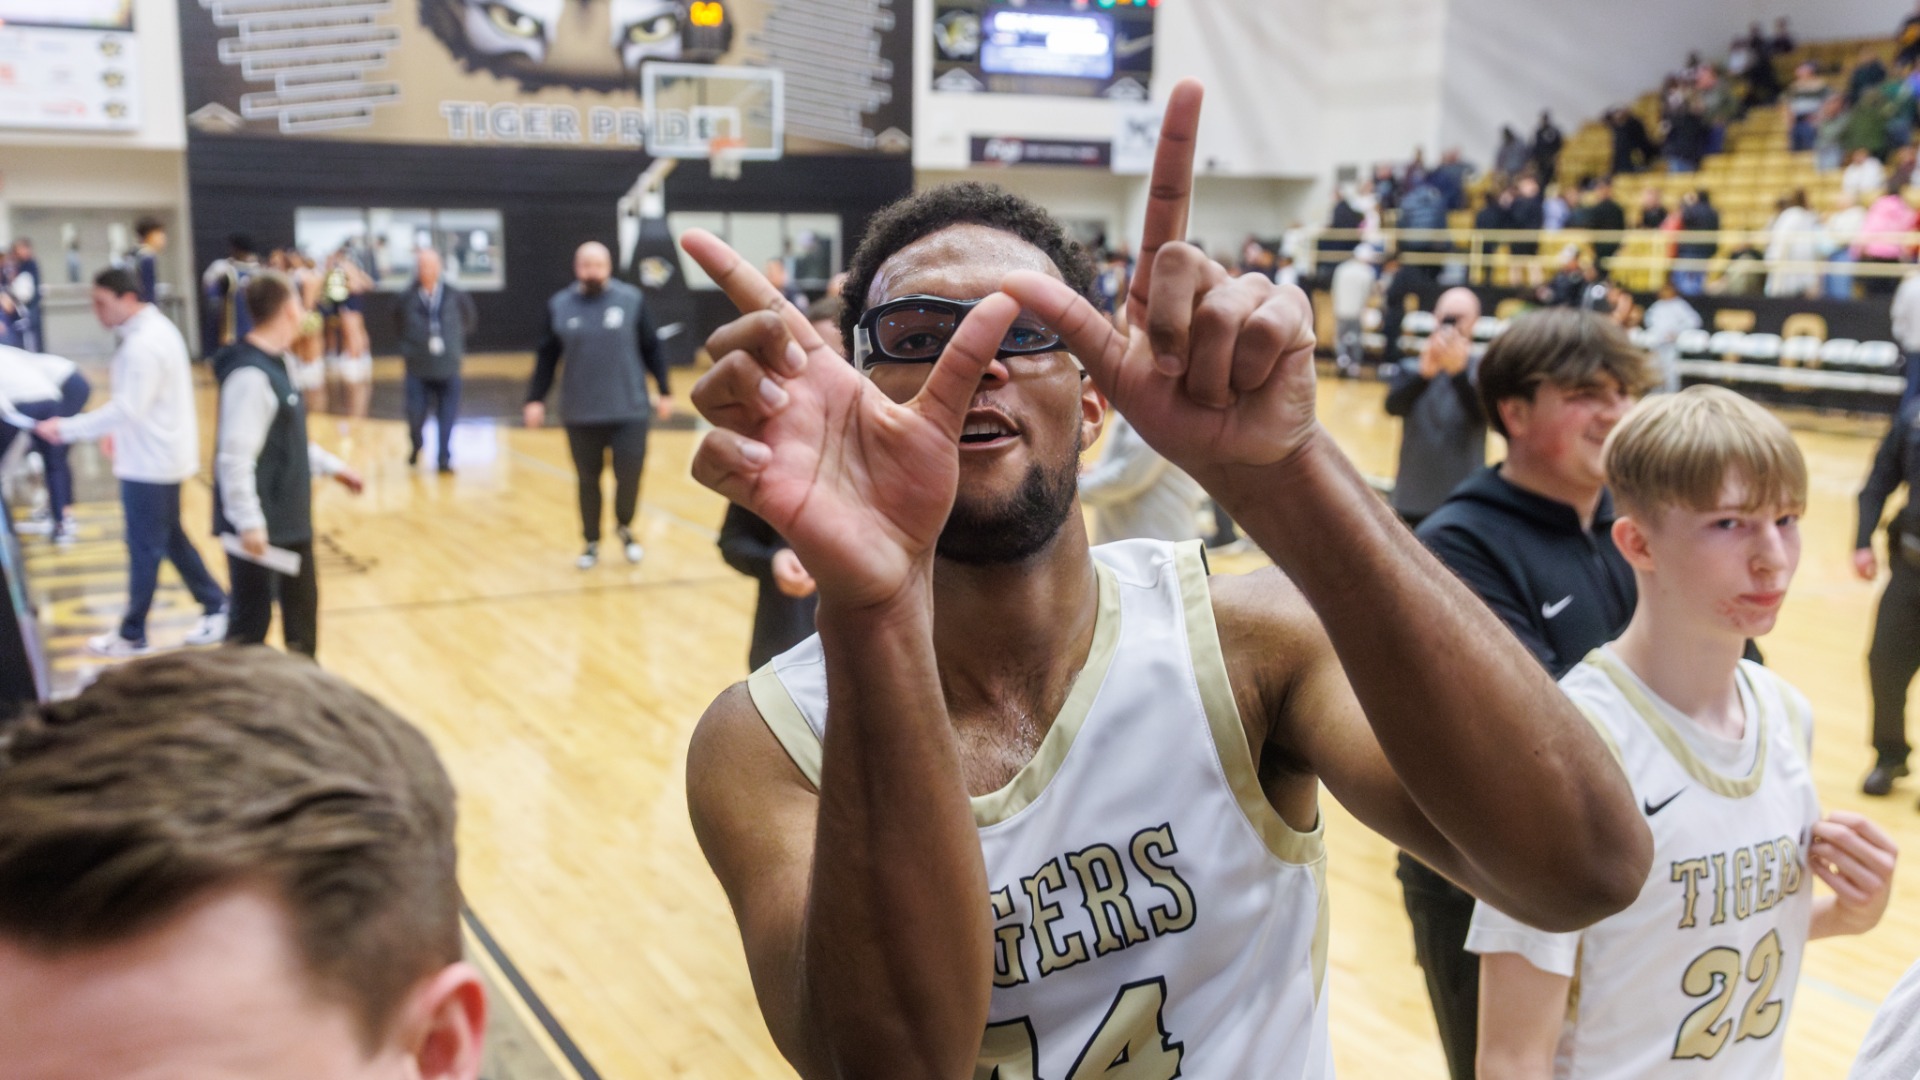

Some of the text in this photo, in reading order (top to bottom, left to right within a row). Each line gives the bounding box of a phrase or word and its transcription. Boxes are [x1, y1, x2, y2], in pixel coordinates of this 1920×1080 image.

[441, 101, 582, 141] TIGER
[991, 822, 1197, 989] GERS
[1670, 928, 1784, 1060] 22
